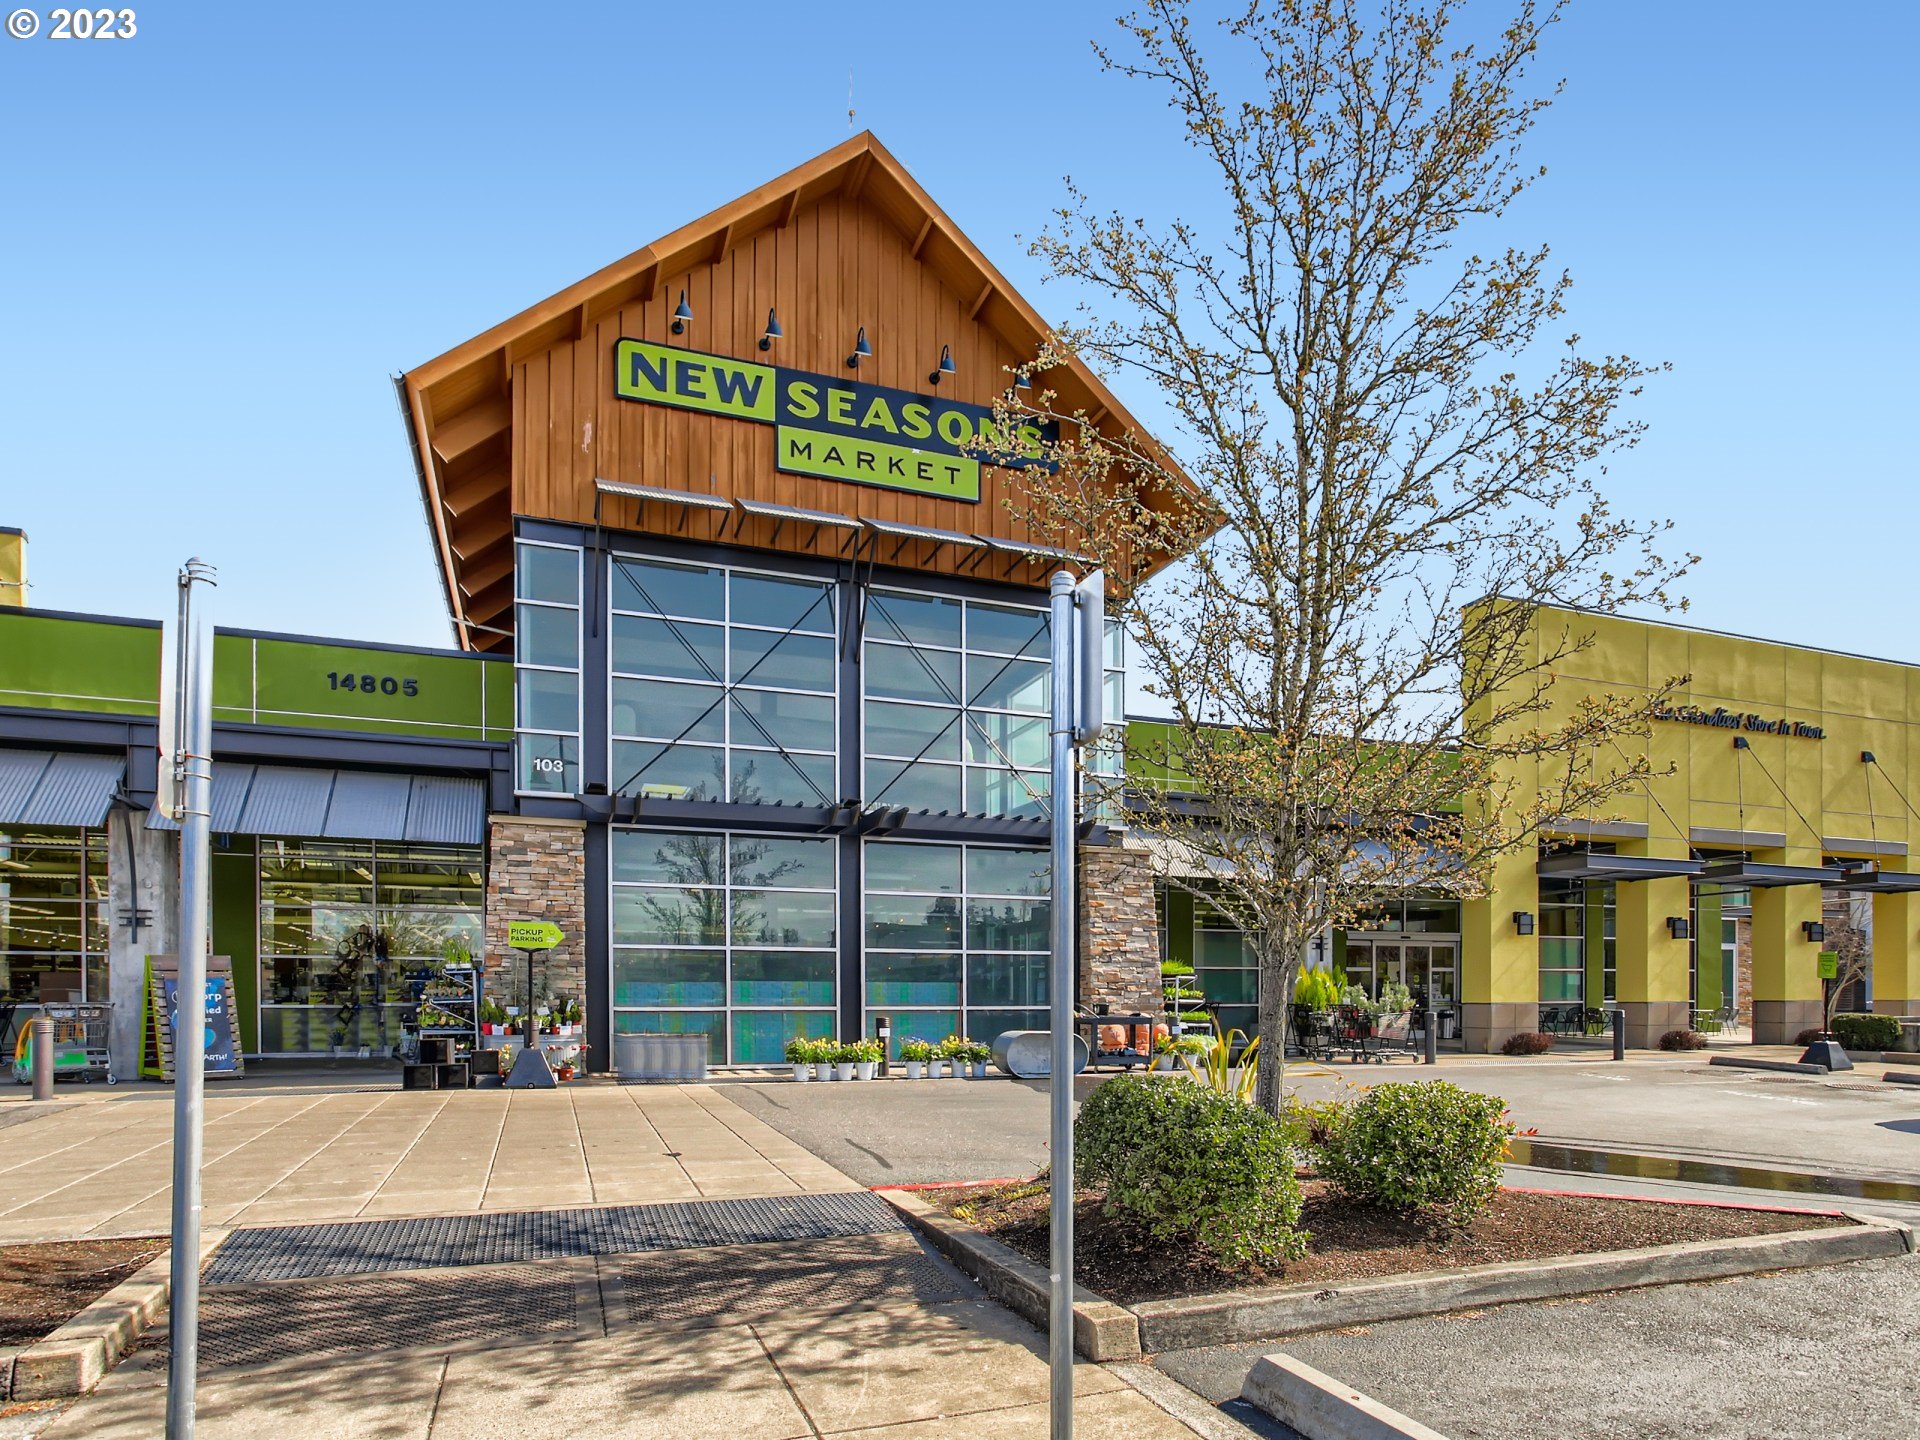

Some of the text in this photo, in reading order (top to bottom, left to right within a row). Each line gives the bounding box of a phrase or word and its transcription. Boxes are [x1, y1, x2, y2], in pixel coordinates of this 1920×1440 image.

[630, 351, 764, 408] NEW
[789, 439, 961, 485] MARKET
[327, 672, 419, 697] 14805
[1743, 713, 1777, 734] Store
[534, 758, 564, 773] 103
[511, 928, 543, 936] PICKUP
[511, 935, 543, 943] PARKING
